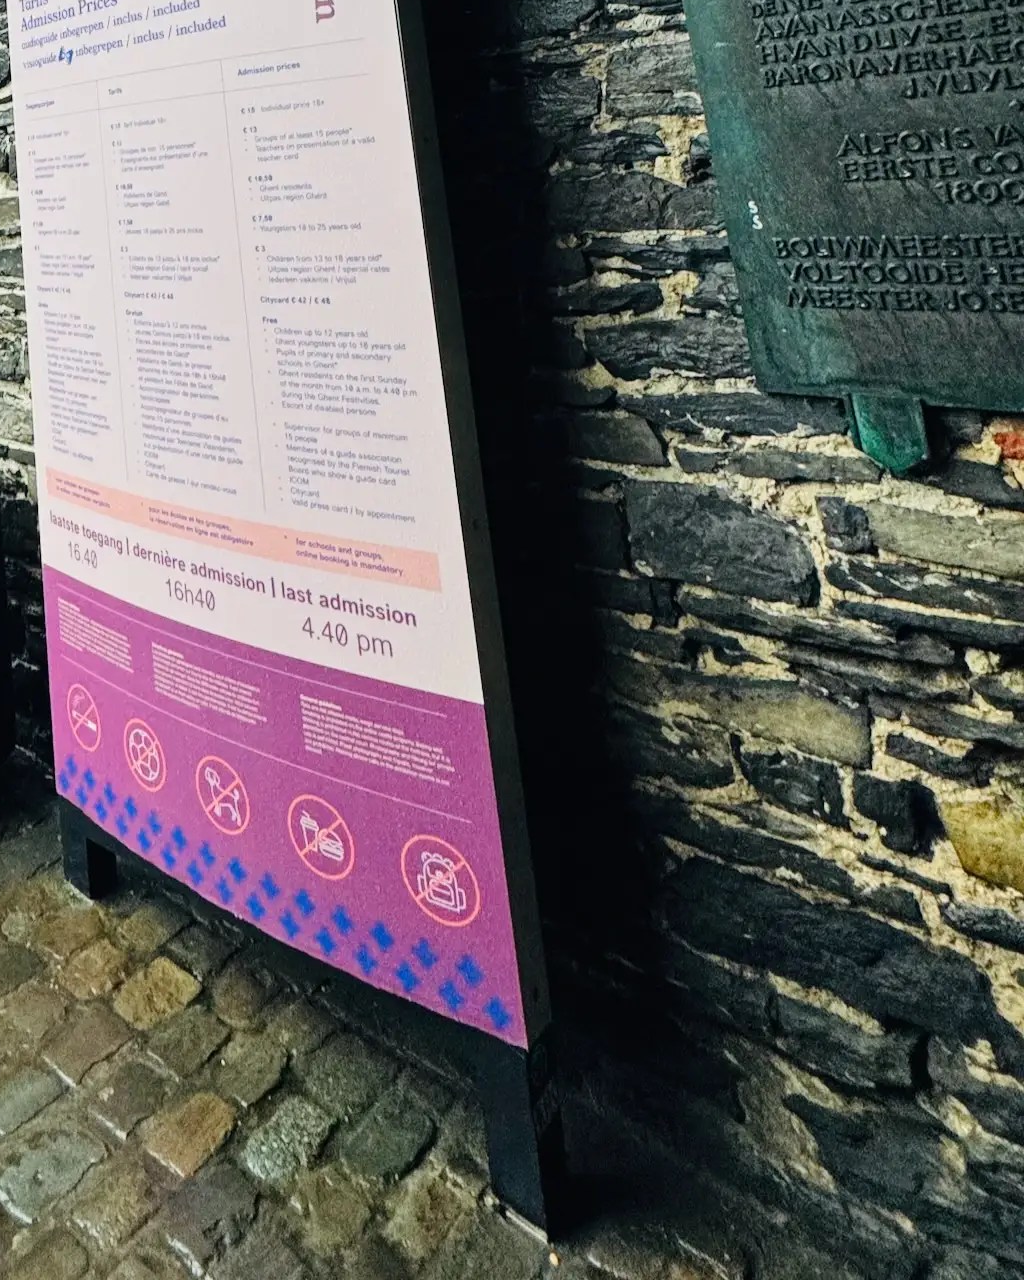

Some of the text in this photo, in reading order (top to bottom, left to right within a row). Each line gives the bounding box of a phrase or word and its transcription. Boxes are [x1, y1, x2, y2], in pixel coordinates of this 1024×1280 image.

[20, 4, 76, 33] Admission
[21, 31, 58, 51] audioguide
[59, 19, 104, 41] inbegrepen
[113, 7, 143, 26] inclus
[22, 51, 57, 70] visioguide
[75, 38, 124, 58] inbegrepen
[133, 28, 165, 45] inclus
[175, 15, 227, 37] included
[237, 61, 301, 77] Admission prices
[836, 126, 974, 158] ALFONS
[838, 155, 959, 183] EERSTE
[328, 224, 349, 232] years
[350, 222, 362, 230] old
[784, 261, 967, 285] VOLTOOIDE
[787, 286, 936, 311] MEESTER
[262, 316, 278, 324] Free
[273, 327, 303, 336] Children
[335, 331, 354, 339] years
[356, 330, 368, 338] old
[276, 348, 296, 358] Pupils
[306, 351, 334, 360] primary
[336, 351, 350, 359] and
[351, 352, 391, 362] secondary
[298, 340, 336, 349] youngsters
[371, 343, 392, 351] years
[394, 343, 406, 351] old
[277, 359, 303, 368] schools
[278, 369, 299, 378] Ghent
[301, 371, 333, 380] residents
[377, 376, 407, 387] Sunday
[68, 540, 98, 569] 16.40
[296, 538, 306, 547] for
[308, 539, 336, 552] schools
[338, 546, 352, 555] and
[296, 550, 318, 560] online
[319, 552, 349, 567] booking
[49, 509, 80, 535] laatste
[82, 524, 123, 555] toegang
[133, 543, 186, 571] dernière
[190, 562, 266, 595] admission
[281, 581, 313, 605] last
[319, 593, 417, 628] admission
[165, 577, 216, 612] 16h40
[302, 616, 394, 659] 4.40 pm
